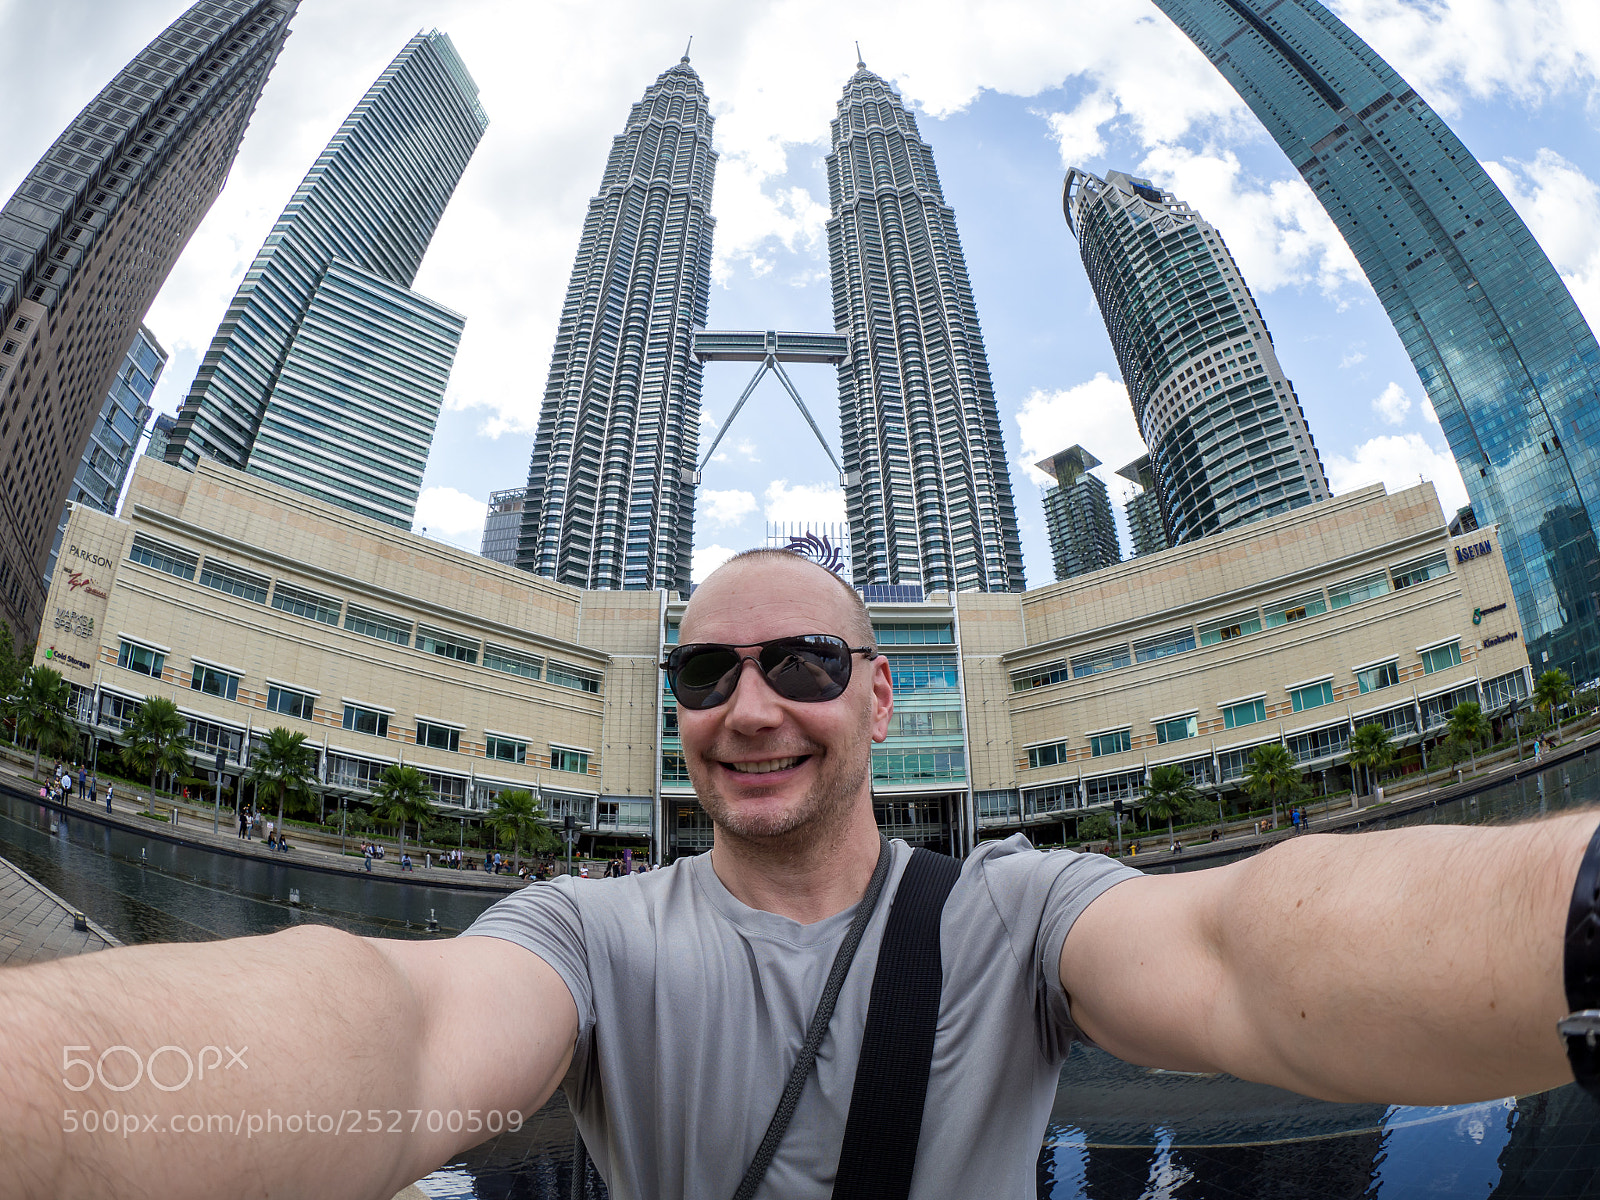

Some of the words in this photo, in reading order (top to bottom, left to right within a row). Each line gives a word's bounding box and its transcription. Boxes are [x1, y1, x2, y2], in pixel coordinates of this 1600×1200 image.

[69, 545, 112, 569] PARKSON
[54, 617, 93, 639] SPENCER
[56, 608, 88, 627] MARKS
[88, 618, 95, 630] &
[1483, 631, 1518, 649] Kinokuniya
[53, 650, 67, 661] Cold
[67, 655, 91, 670] Storage
